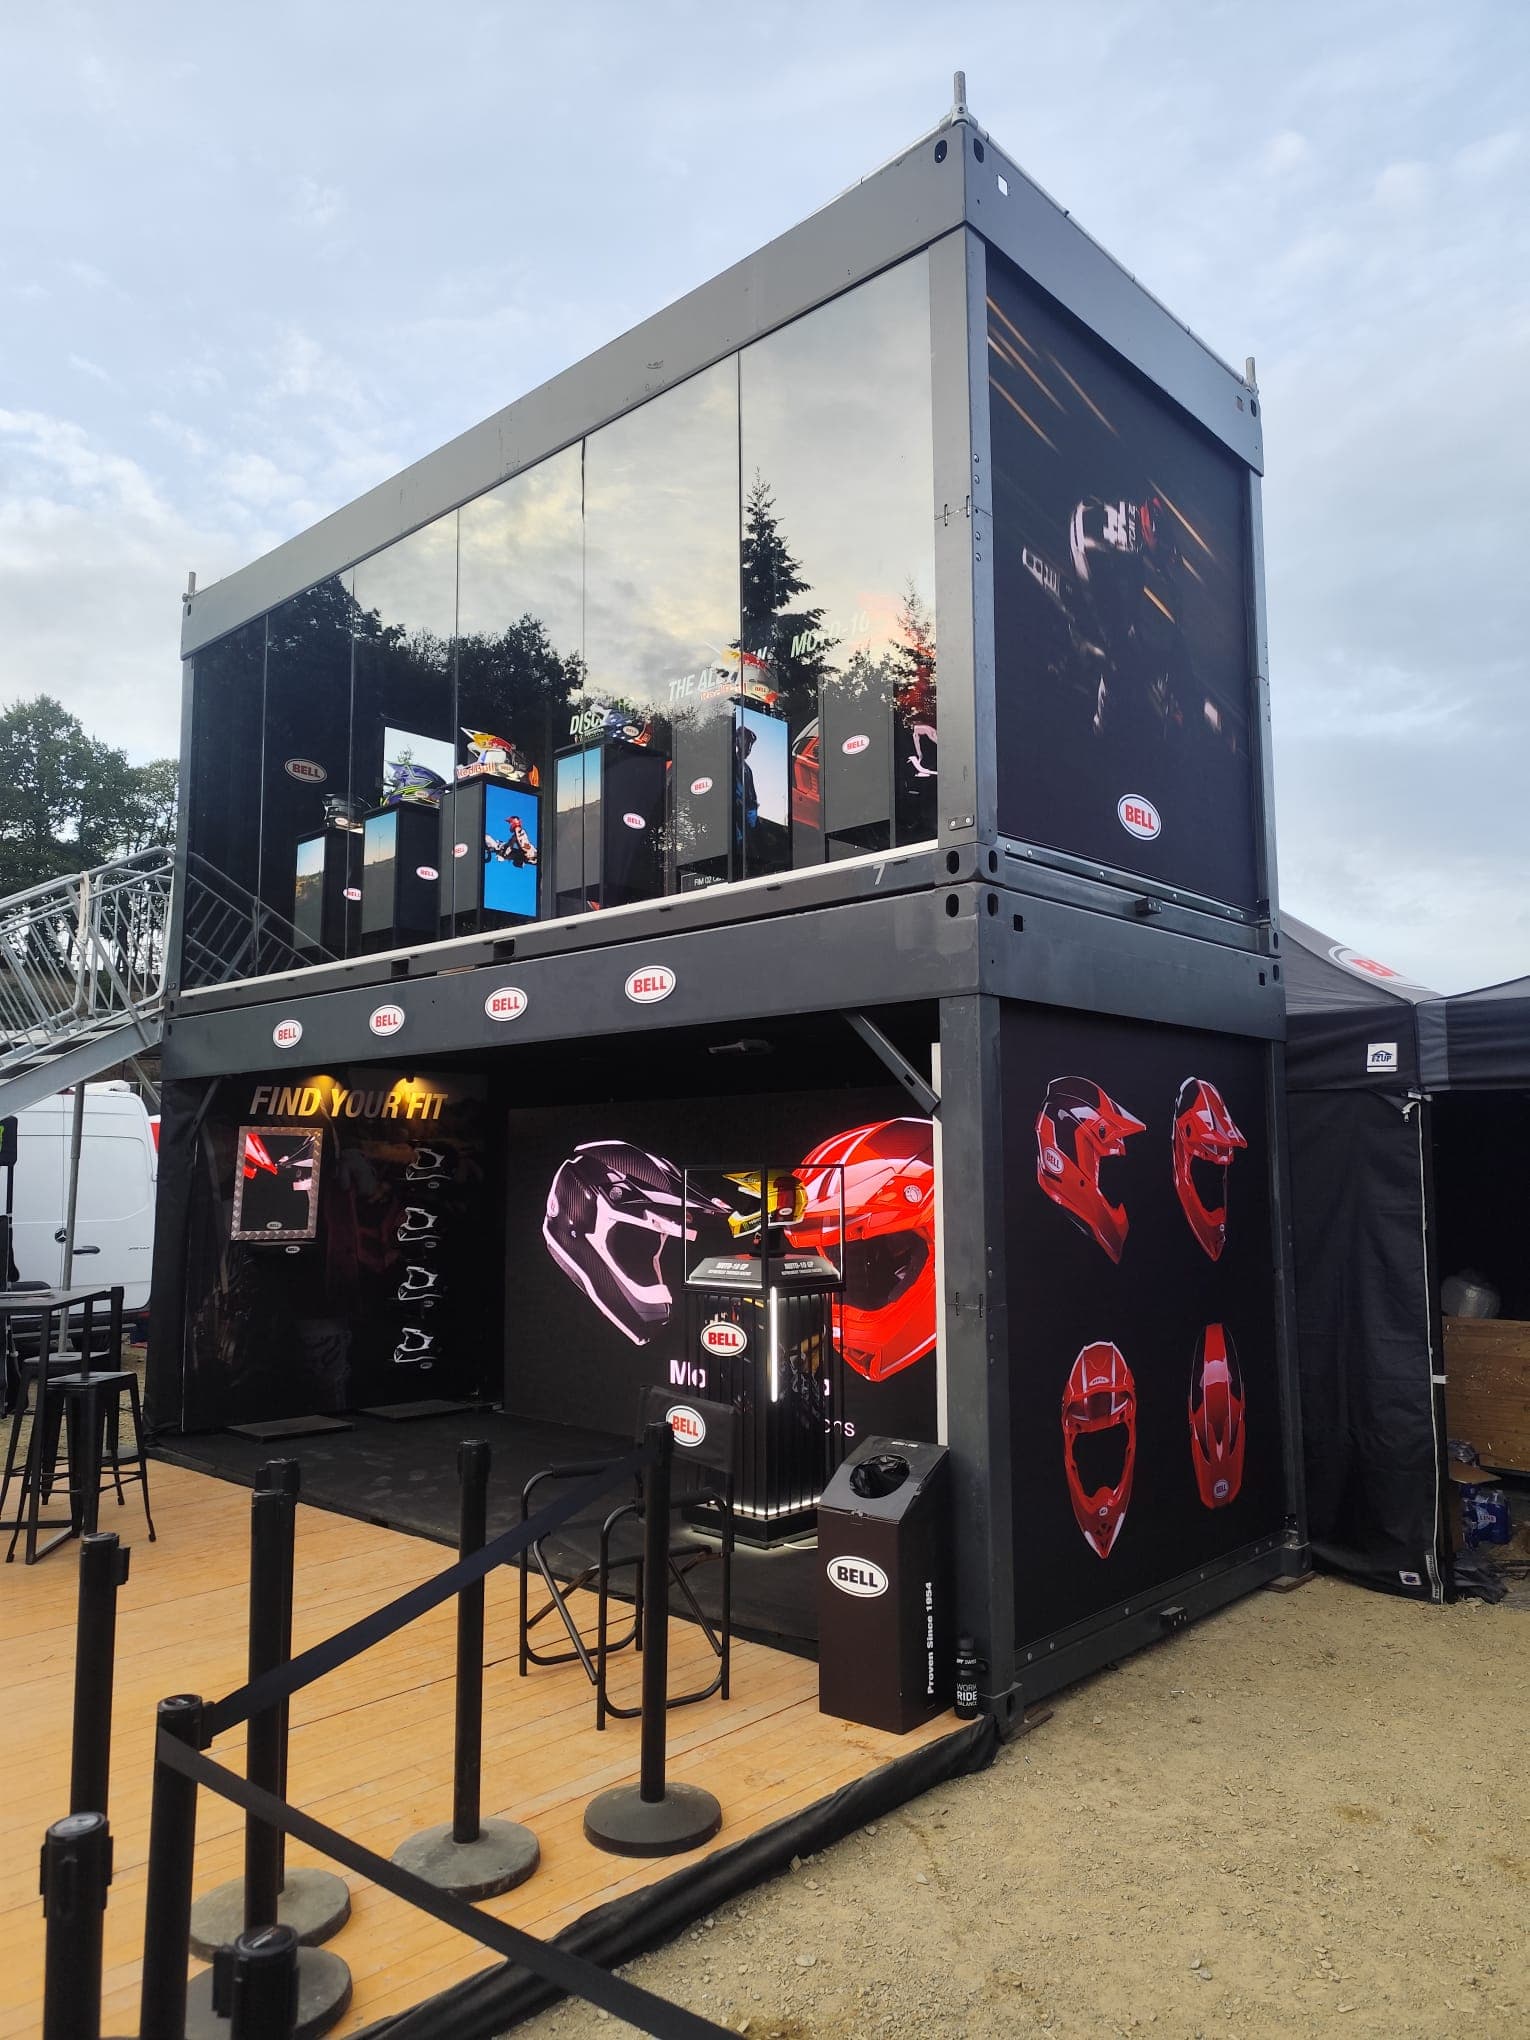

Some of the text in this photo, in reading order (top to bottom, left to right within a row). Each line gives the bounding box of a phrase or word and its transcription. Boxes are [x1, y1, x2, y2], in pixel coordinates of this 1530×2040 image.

[669, 674, 695, 701] THE
[847, 740, 865, 750] BELL
[292, 763, 321, 778] BELL
[694, 782, 709, 791] BELL
[627, 816, 642, 826] BELL
[1125, 803, 1155, 830] BELL
[633, 975, 667, 993] BELL
[492, 996, 520, 1012] BELL
[375, 1013, 398, 1027] BELL
[278, 1028, 297, 1041] BELL
[250, 1086, 448, 1120] FIND YOUR FIT
[708, 1331, 739, 1347] BELL
[672, 1415, 698, 1437] BELL
[837, 1565, 878, 1588] BELL
[956, 1690, 978, 1702] RIDE
